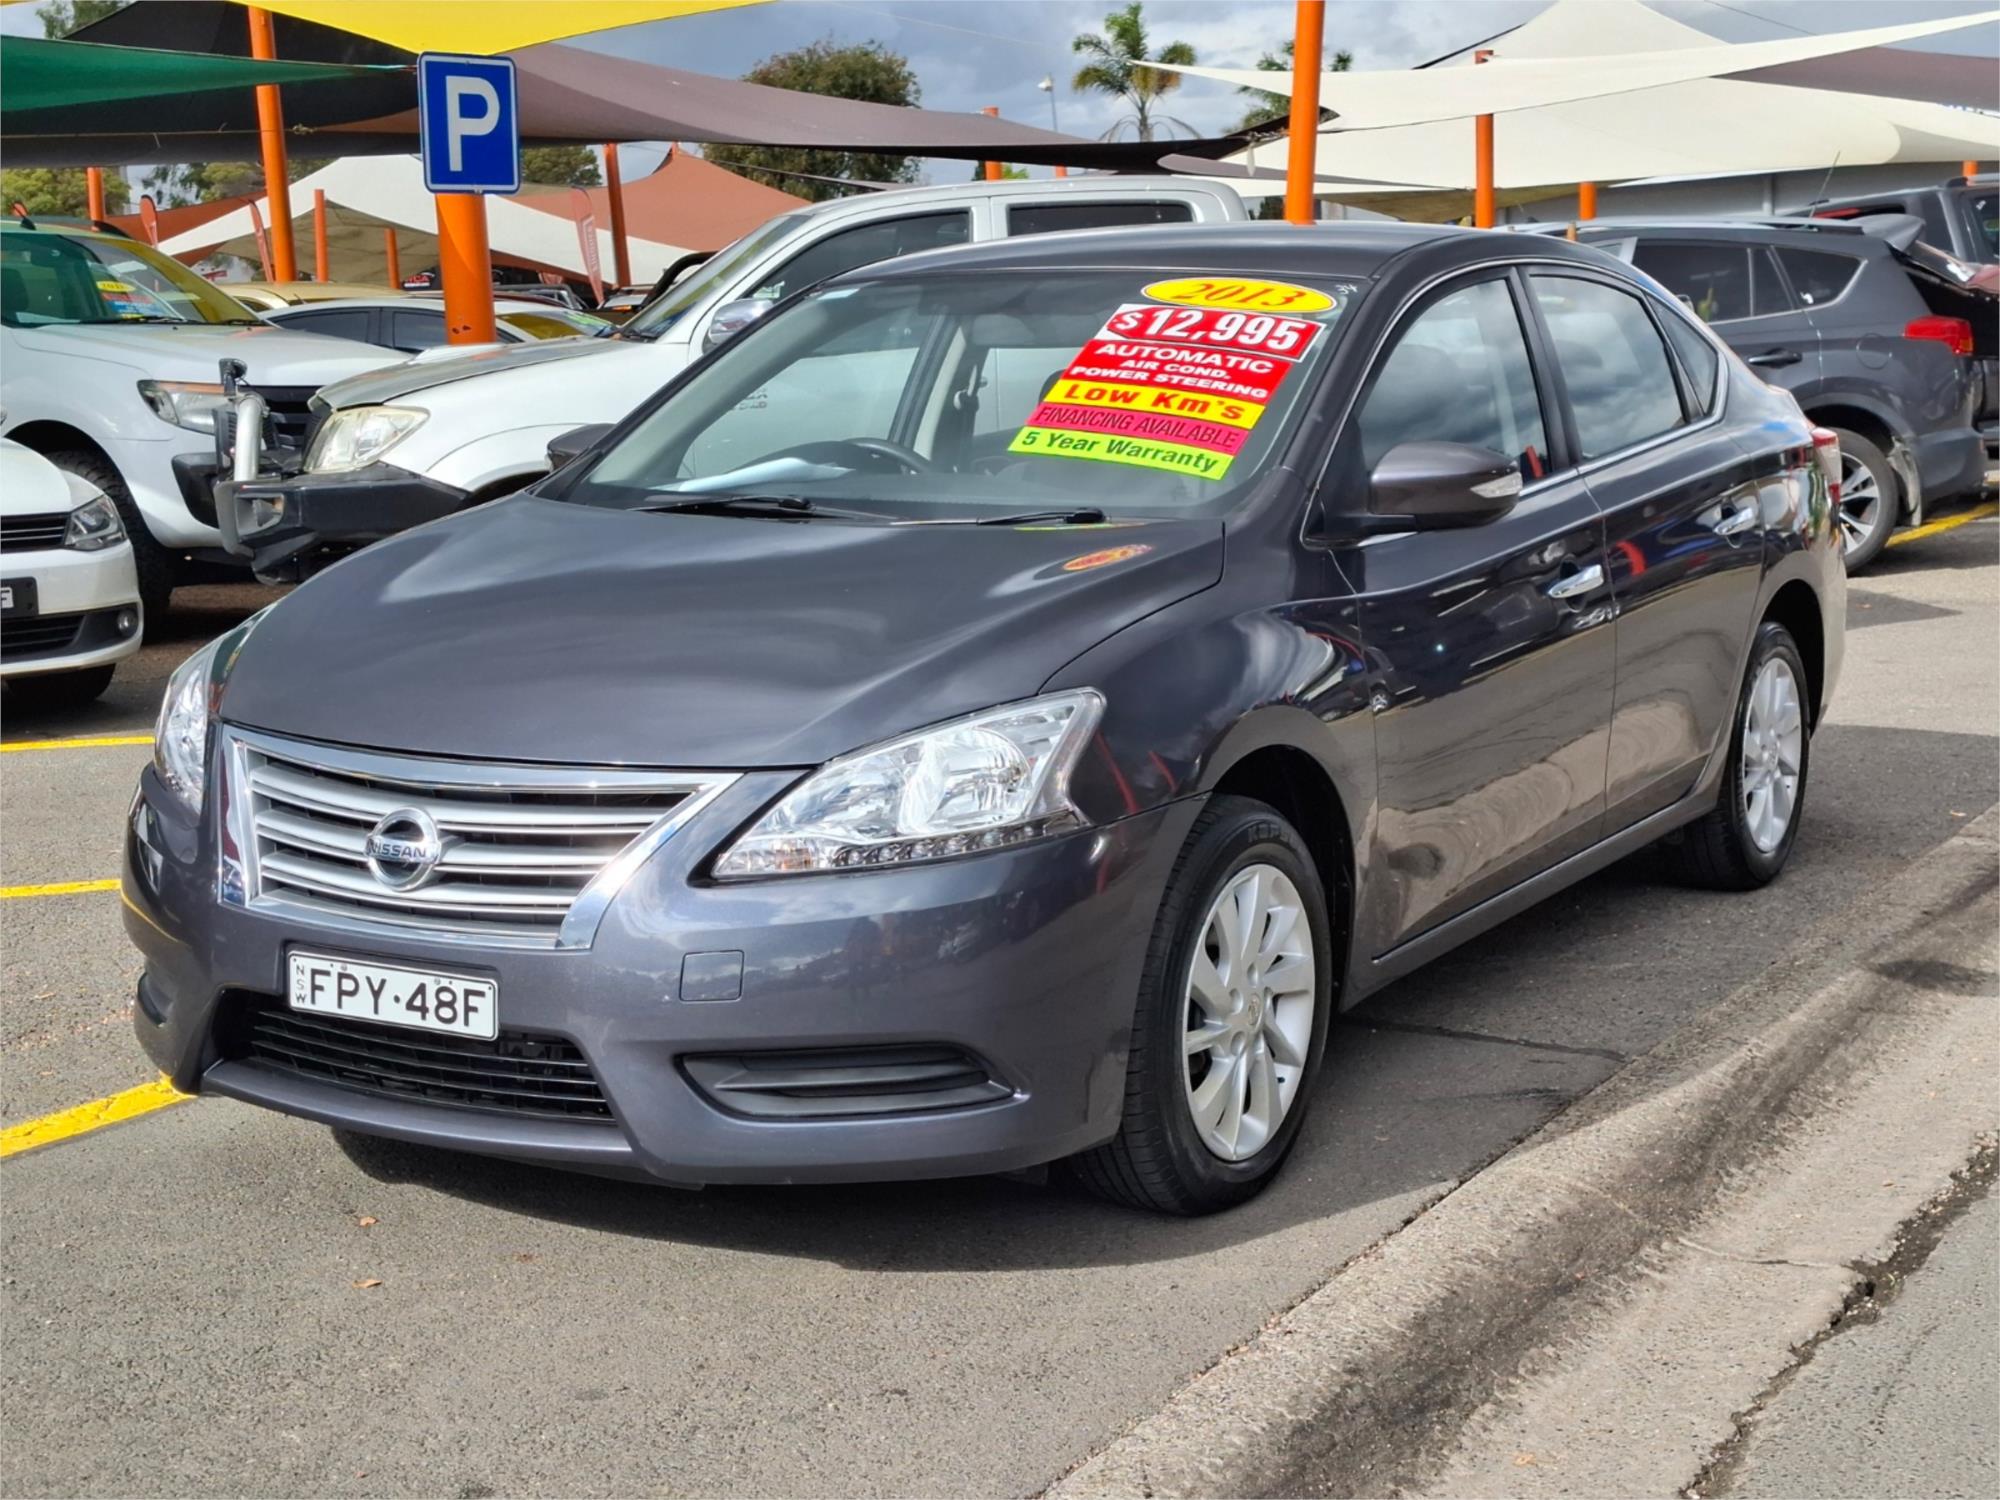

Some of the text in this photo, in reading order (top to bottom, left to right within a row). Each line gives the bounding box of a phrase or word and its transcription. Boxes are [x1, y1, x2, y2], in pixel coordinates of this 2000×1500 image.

[445, 75, 500, 172] P
[1170, 283, 1307, 306] 2013
[1115, 308, 1307, 351] $12,995
[1095, 343, 1274, 374] AUTOMATIC
[1120, 359, 1232, 380] AIR COND.
[1070, 366, 1269, 399] POWER STEERING
[1034, 406, 1239, 448] FINANCING AVAILABLE
[1022, 431, 1218, 472] 5 Year Warranty
[366, 839, 427, 859] NISSAN
